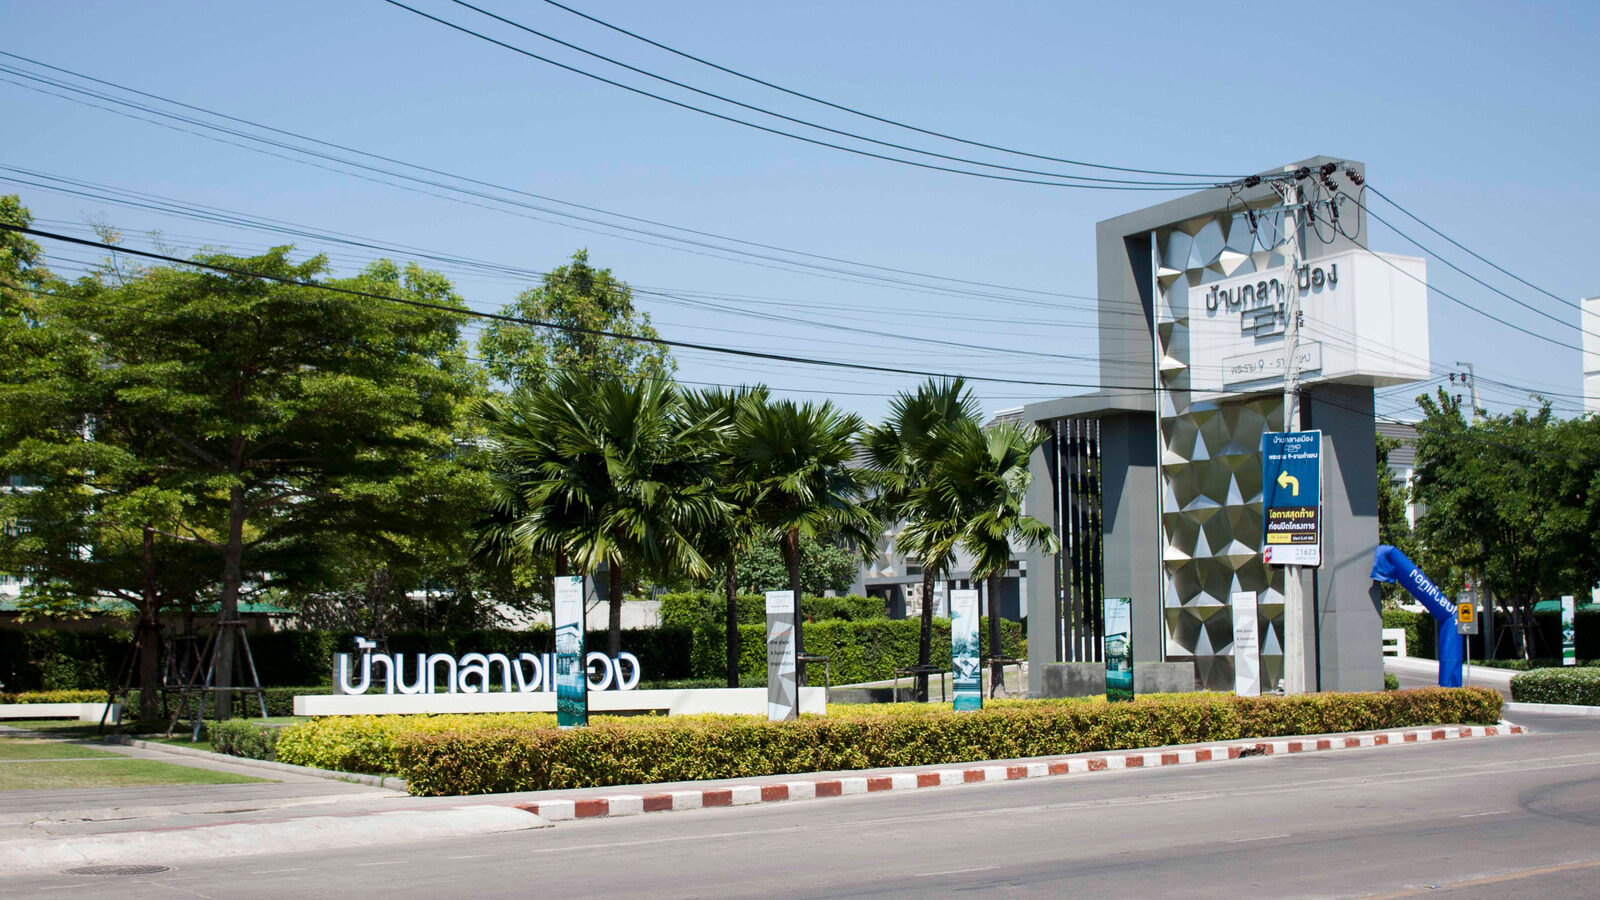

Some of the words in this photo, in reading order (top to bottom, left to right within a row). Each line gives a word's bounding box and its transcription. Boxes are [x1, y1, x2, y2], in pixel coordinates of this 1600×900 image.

[1206, 263, 1338, 311] บ้านกลามือง
[1268, 521, 1315, 530] ก่อนปิดโครงการ
[1269, 507, 1315, 521] โอกาสสุดท้าย
[337, 636, 641, 695] บ้านกลางเอง
